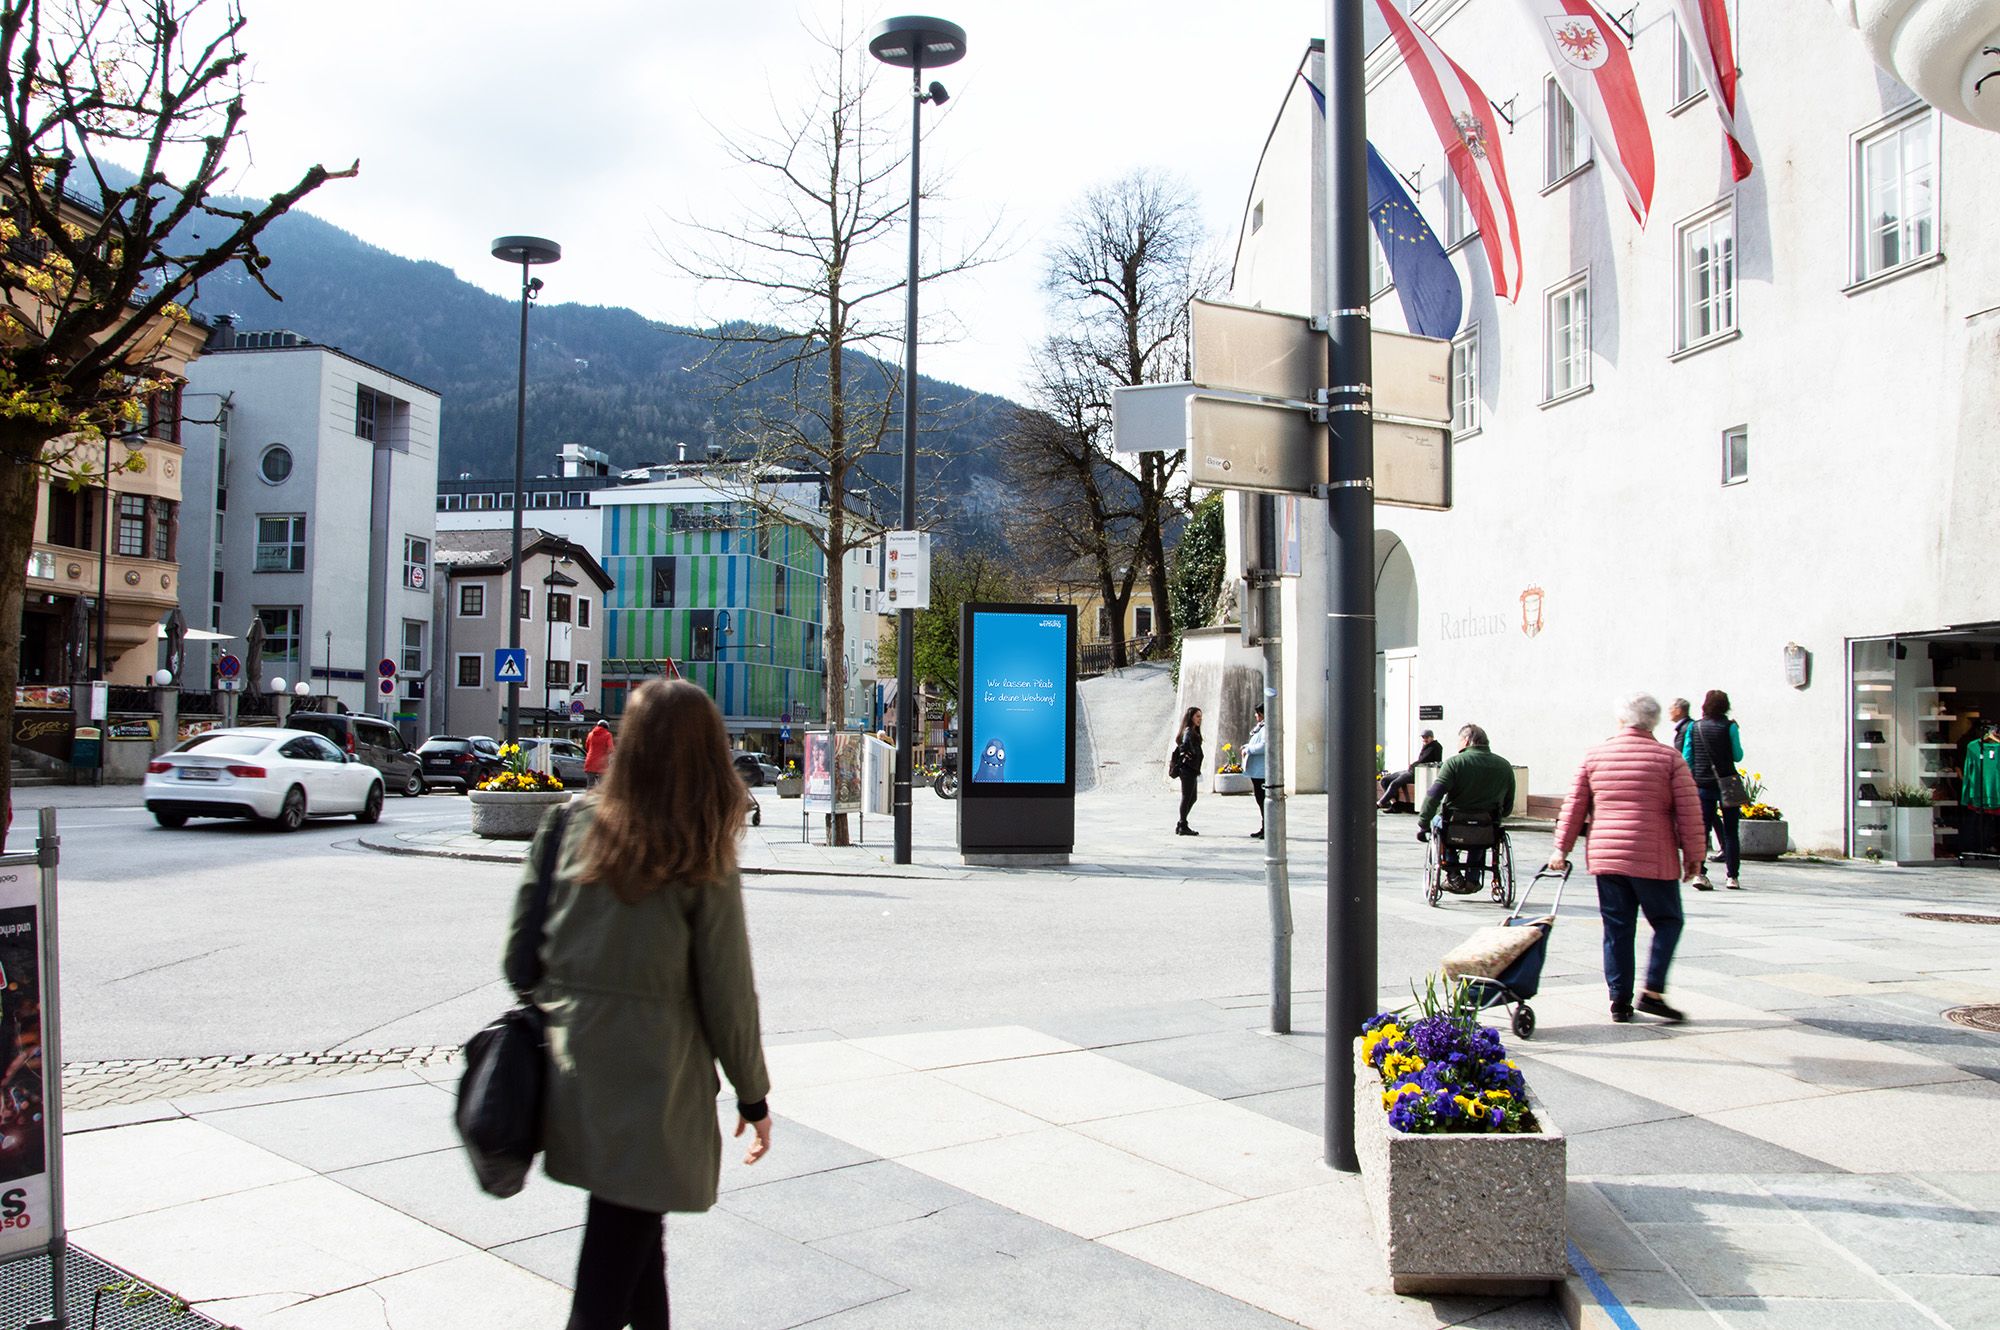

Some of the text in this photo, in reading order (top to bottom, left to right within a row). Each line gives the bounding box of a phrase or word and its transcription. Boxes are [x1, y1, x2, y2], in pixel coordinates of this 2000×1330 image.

[1440, 606, 1506, 640] Rathaus
[987, 678, 1053, 688] Wir lassen Platz
[984, 691, 1056, 706] für deine Werbung!
[17, 922, 31, 936] und
